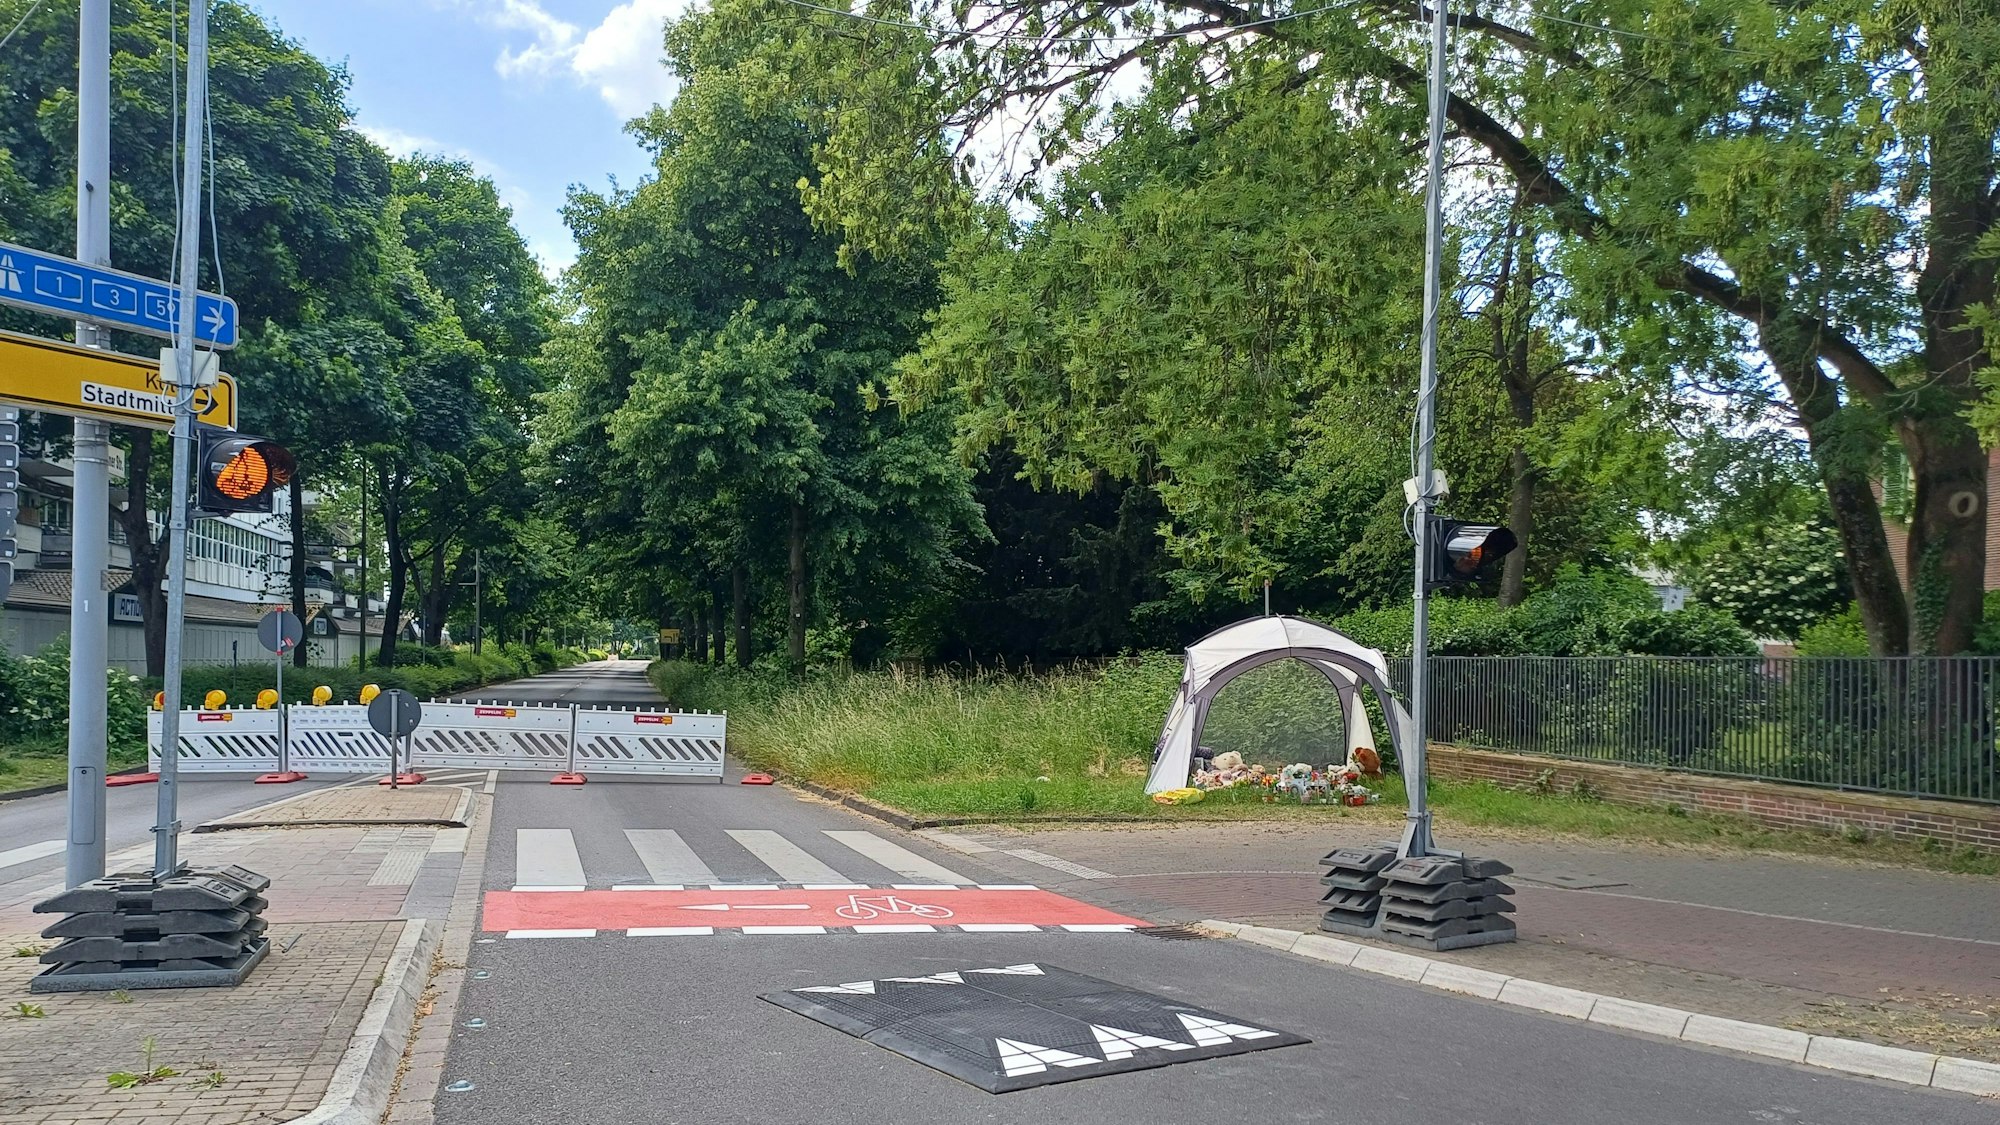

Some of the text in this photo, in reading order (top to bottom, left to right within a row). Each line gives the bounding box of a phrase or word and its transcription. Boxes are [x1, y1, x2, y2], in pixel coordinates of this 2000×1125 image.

[56, 276, 63, 293] 1
[110, 289, 120, 306] 3
[83, 384, 173, 415] Stadtmitt
